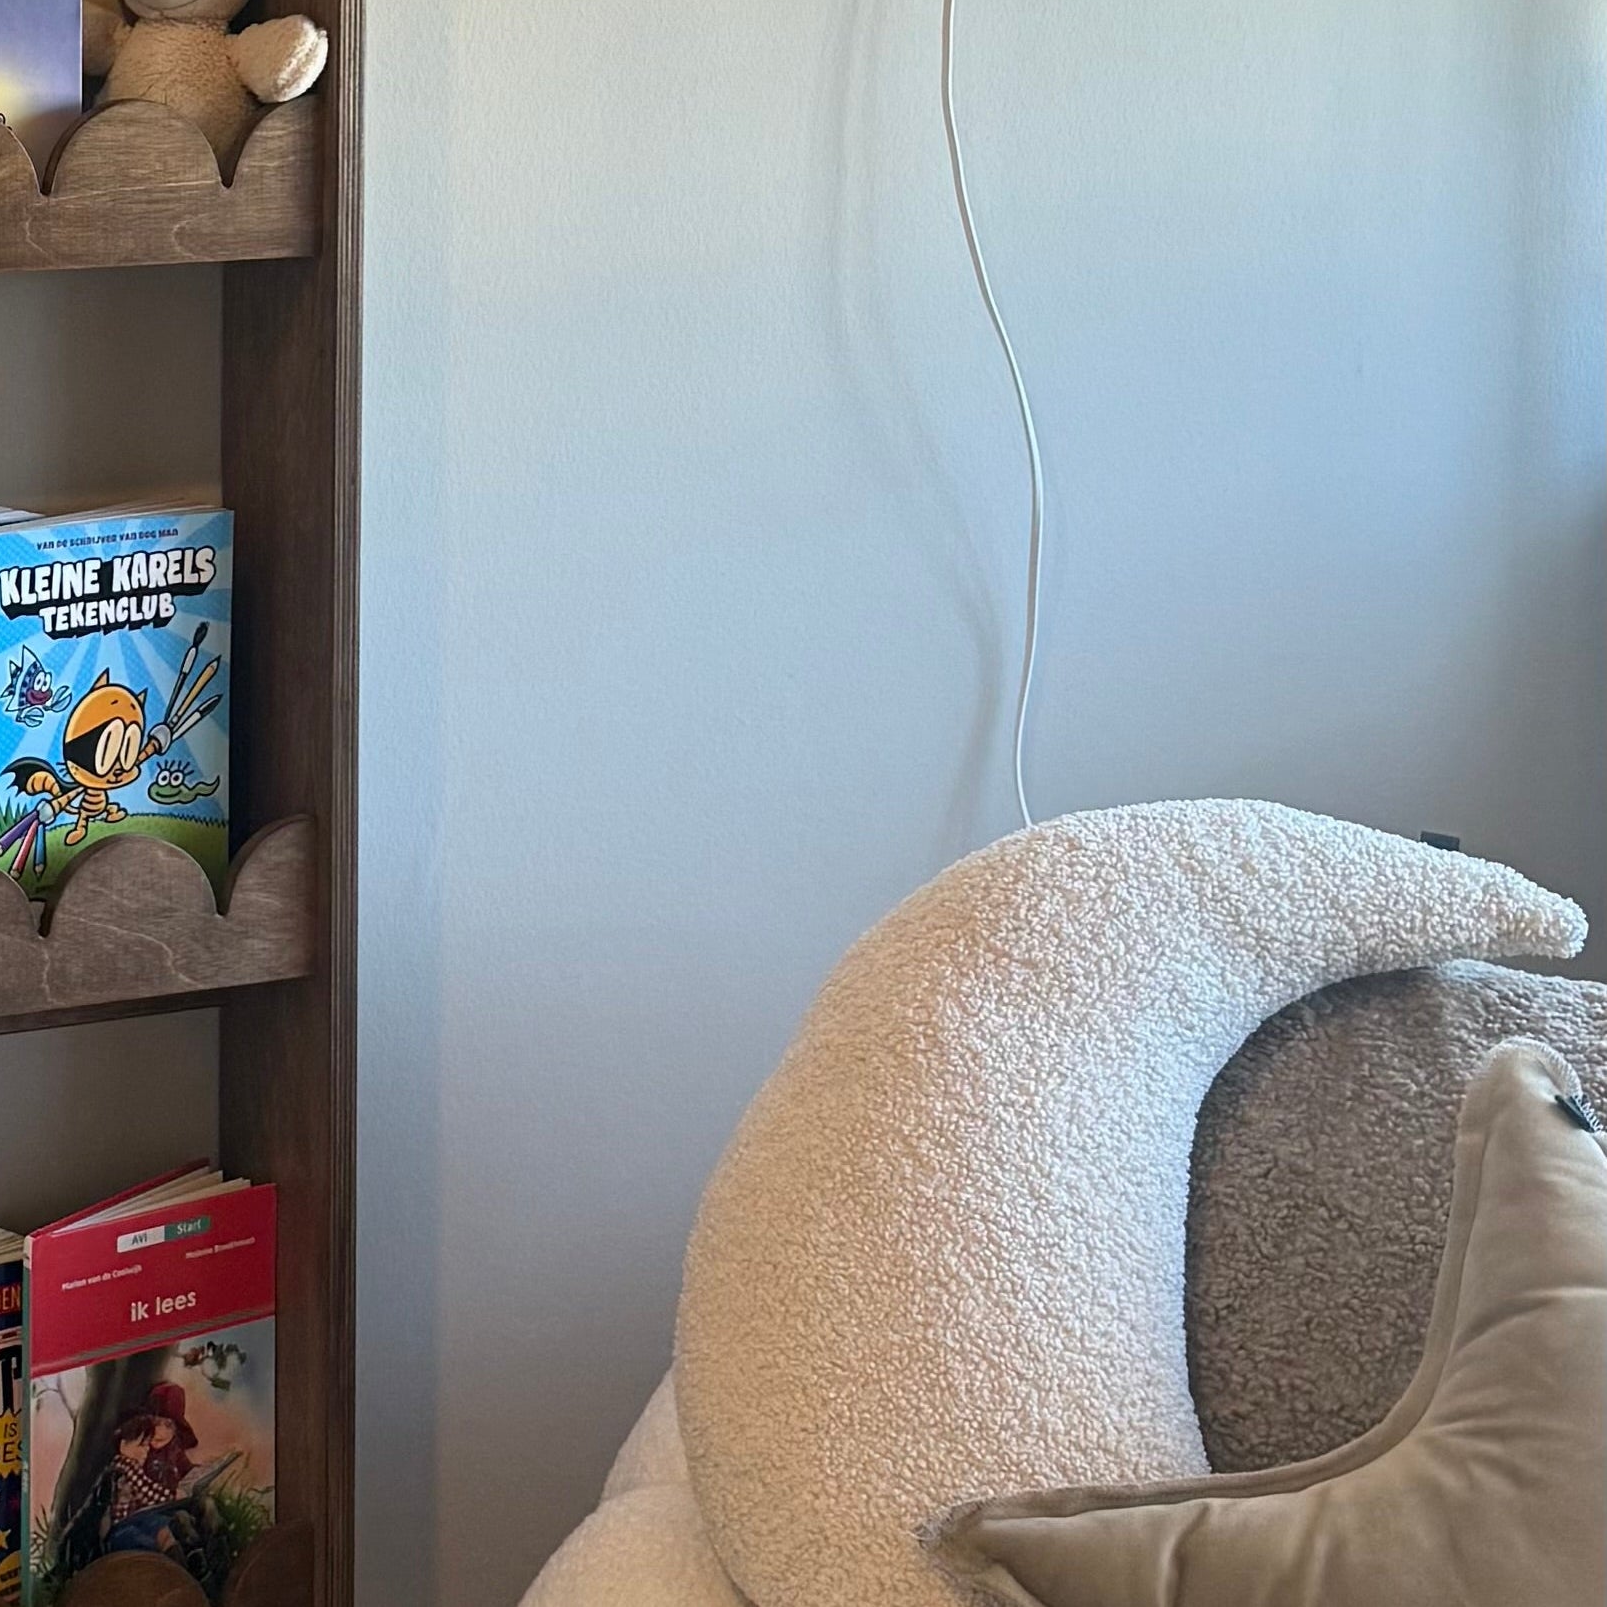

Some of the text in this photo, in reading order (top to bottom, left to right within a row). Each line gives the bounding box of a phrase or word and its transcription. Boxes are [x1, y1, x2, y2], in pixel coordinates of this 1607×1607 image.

[37, 528, 179, 550] VAN DE SCHRIJVER VAN DOG MAN
[0, 559, 101, 607] KLEINE
[112, 547, 216, 593] KARELS
[39, 593, 175, 633] TEKENCLUB
[177, 1219, 202, 1235] Start
[130, 1291, 197, 1322] ik lees
[4, 1422, 18, 1439] IS
